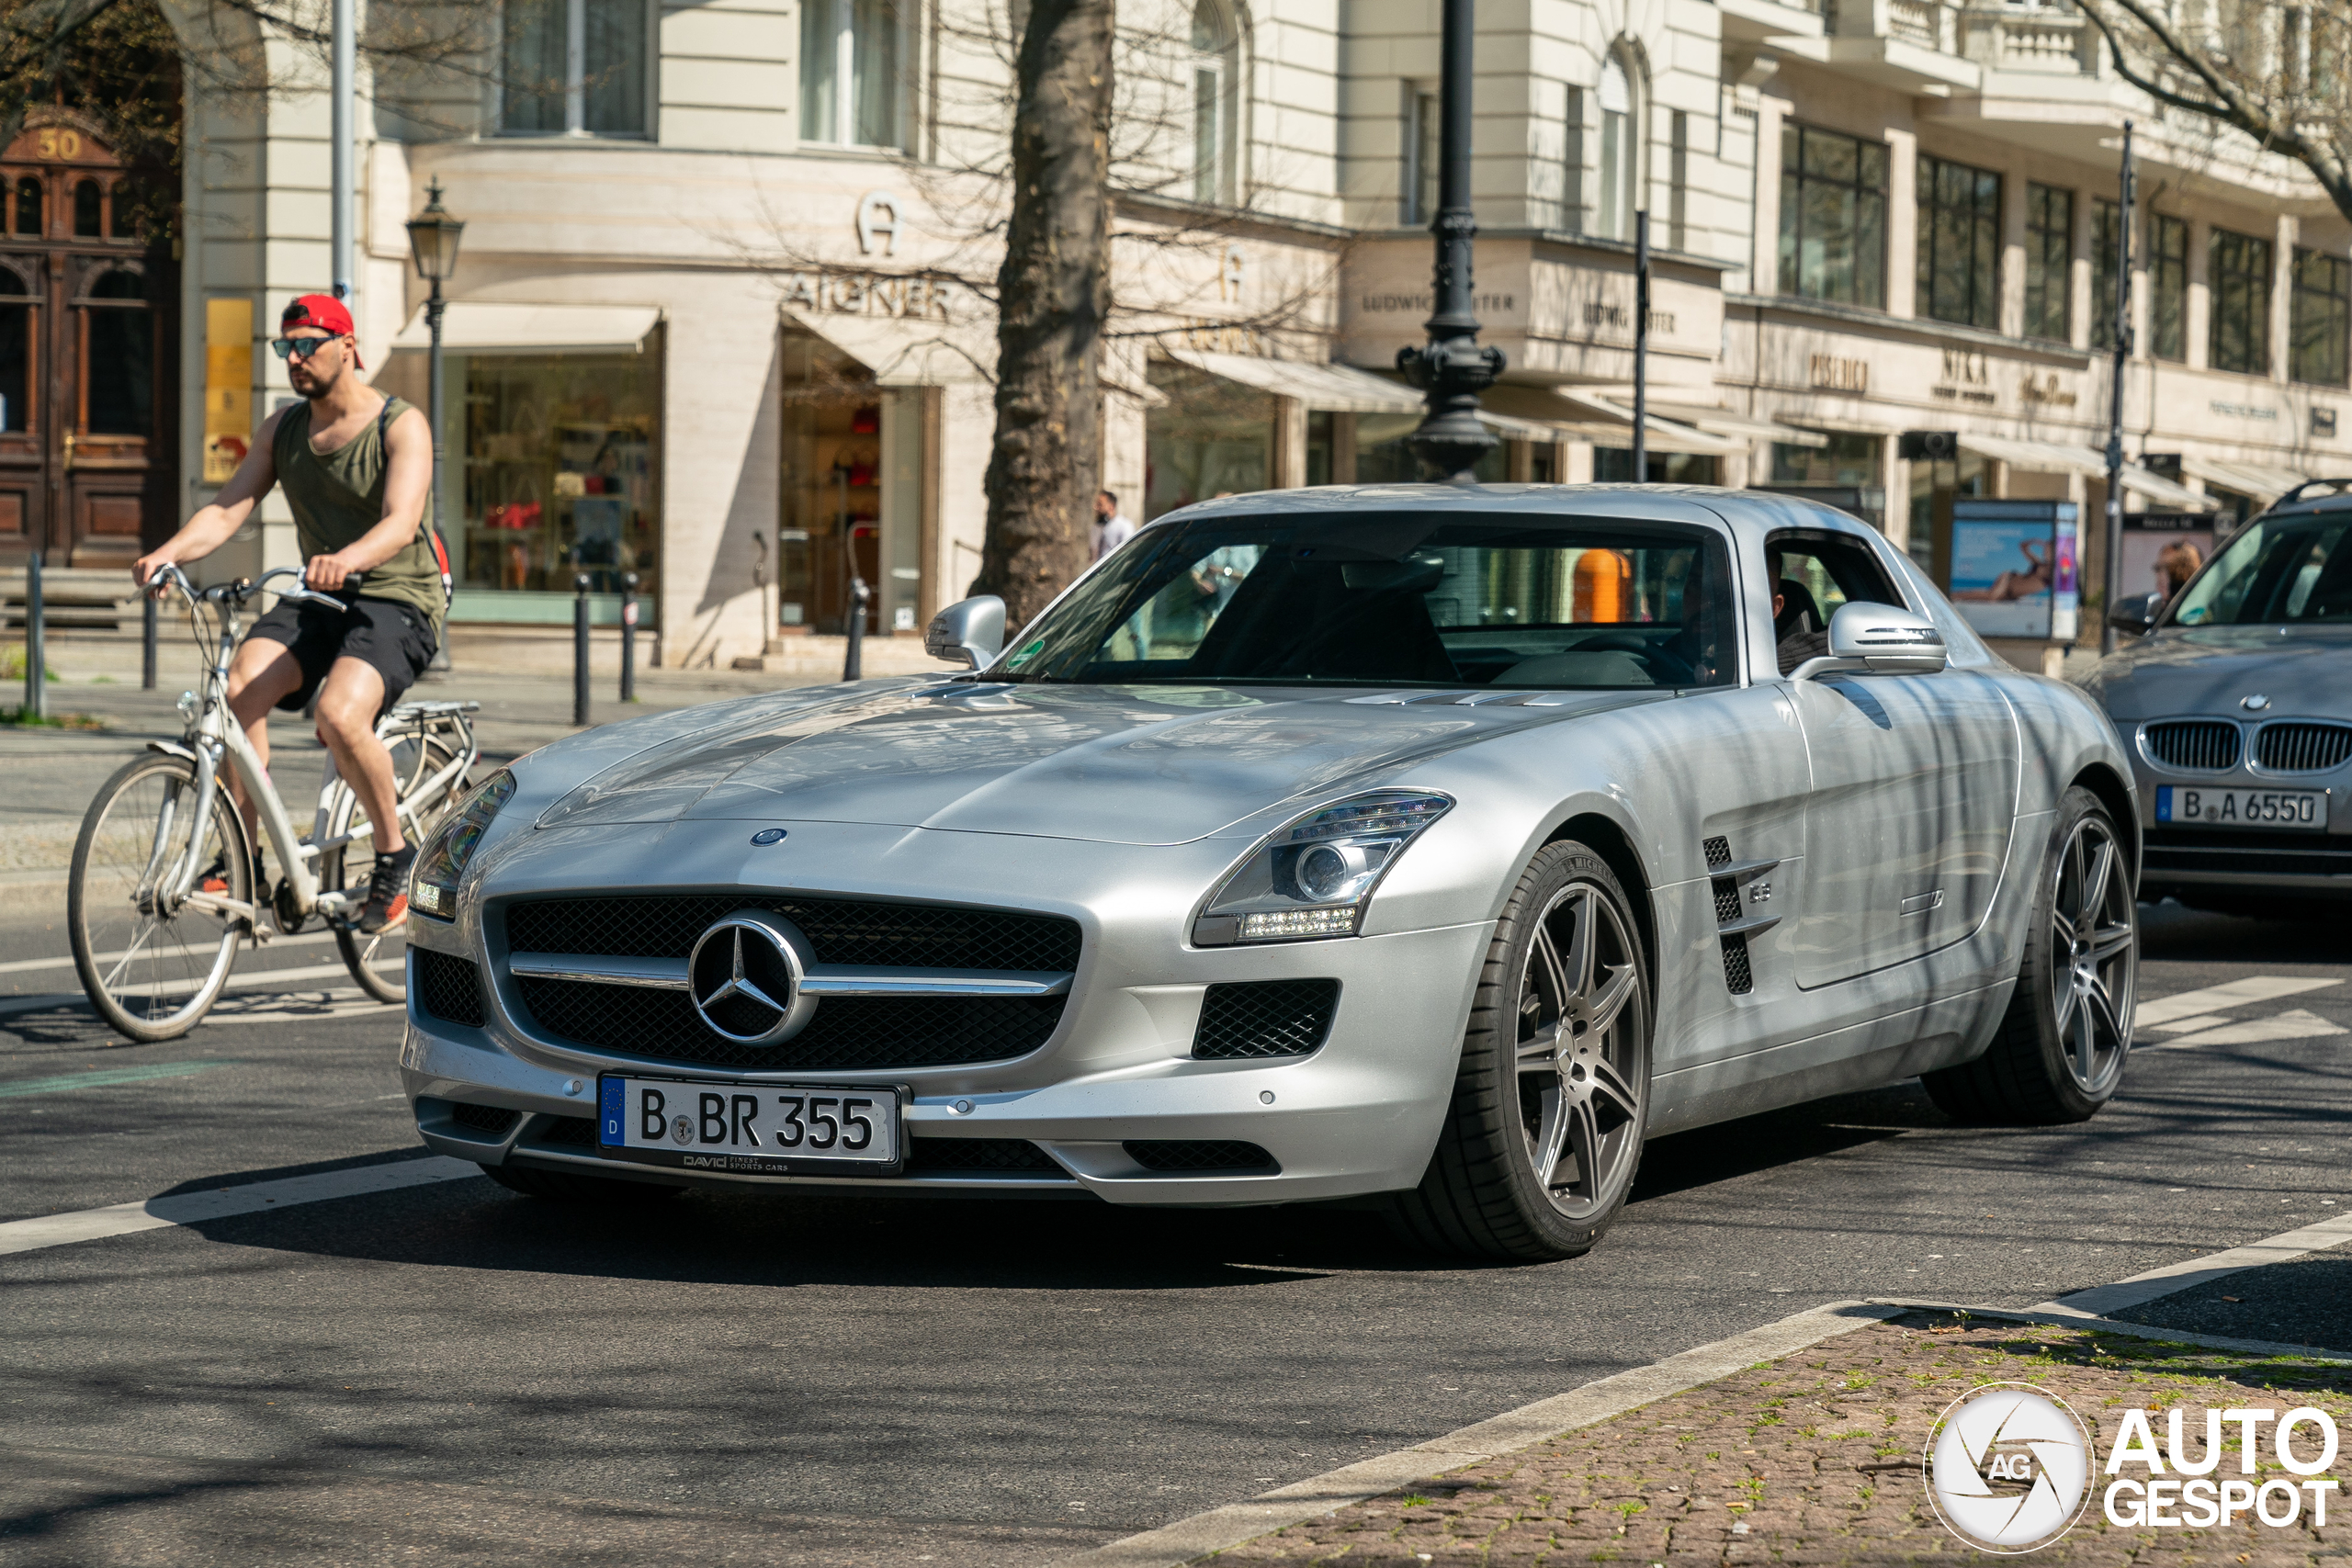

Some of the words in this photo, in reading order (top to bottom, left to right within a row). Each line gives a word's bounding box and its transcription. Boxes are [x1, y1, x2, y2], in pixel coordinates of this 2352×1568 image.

[38, 128, 81, 161] 50
[782, 273, 948, 320] AIGNER
[2185, 791, 2200, 818] B
[2221, 793, 2237, 820] A
[2245, 795, 2315, 823] 6550
[608, 1120, 617, 1134] D
[641, 1089, 667, 1140] B
[699, 1092, 762, 1146] BR
[776, 1095, 874, 1150] 355
